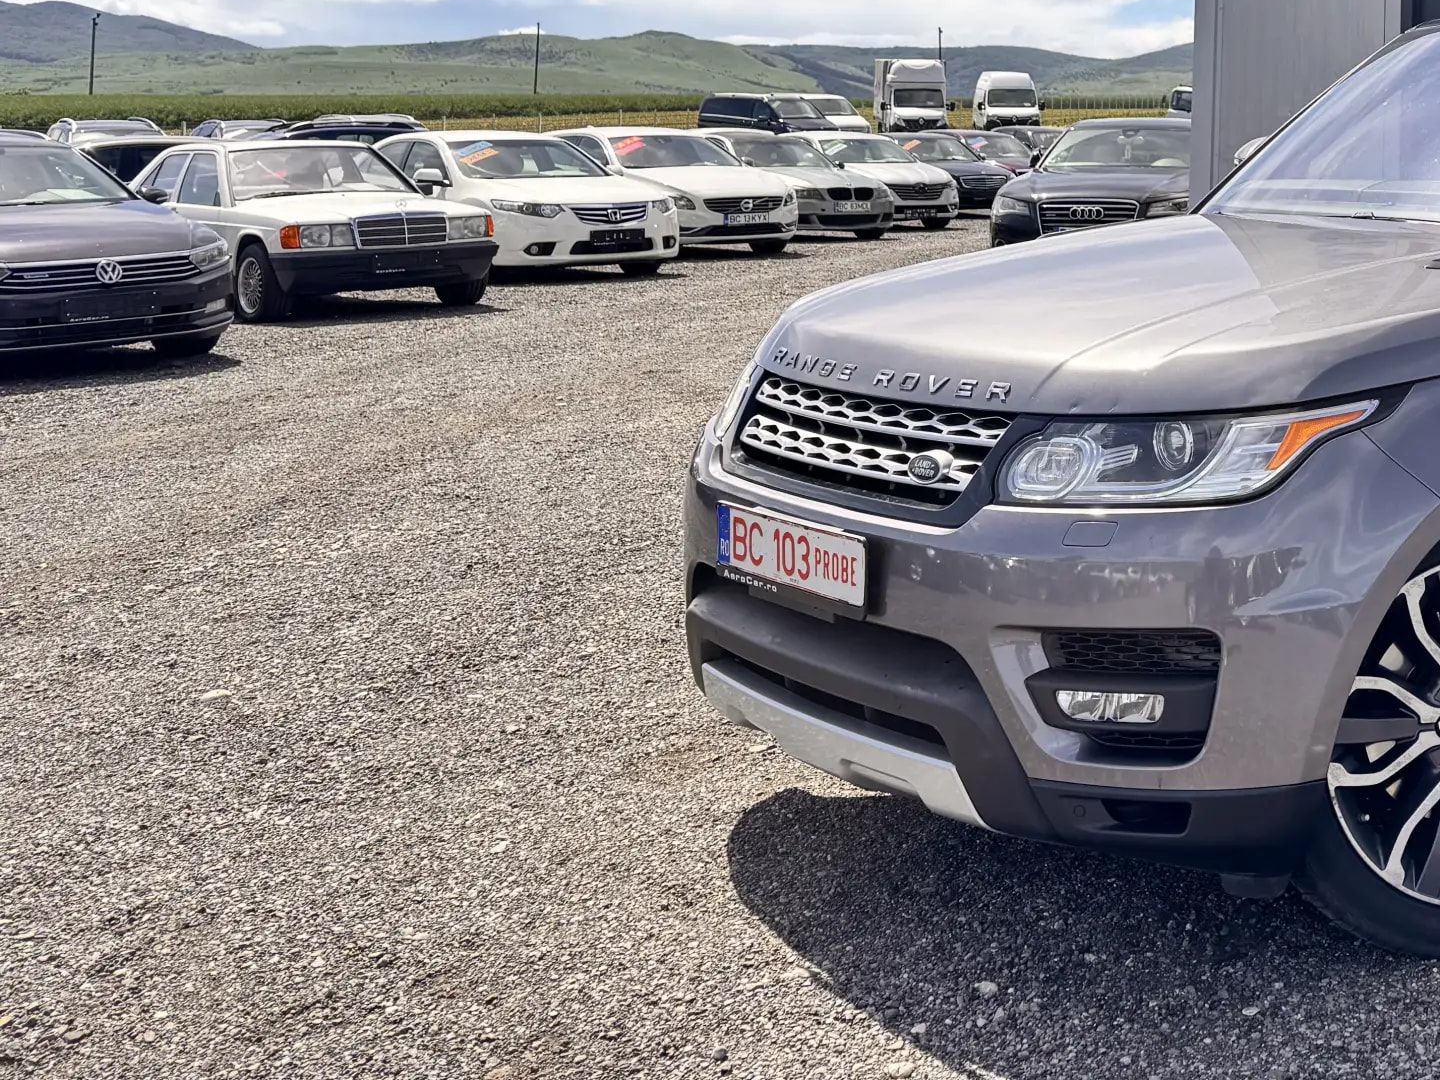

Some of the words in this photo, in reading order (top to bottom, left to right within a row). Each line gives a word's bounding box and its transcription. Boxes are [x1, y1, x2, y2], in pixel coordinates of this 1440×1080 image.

[772, 346, 858, 382] RANGE
[872, 369, 1012, 403] ROVER
[914, 459, 932, 469] LAND
[914, 467, 935, 478] ROVER
[720, 538, 730, 557] RO
[733, 516, 764, 567] BC
[773, 528, 811, 580] 103
[814, 547, 857, 587] PROBE
[723, 569, 778, 593] AeroCar.ro
